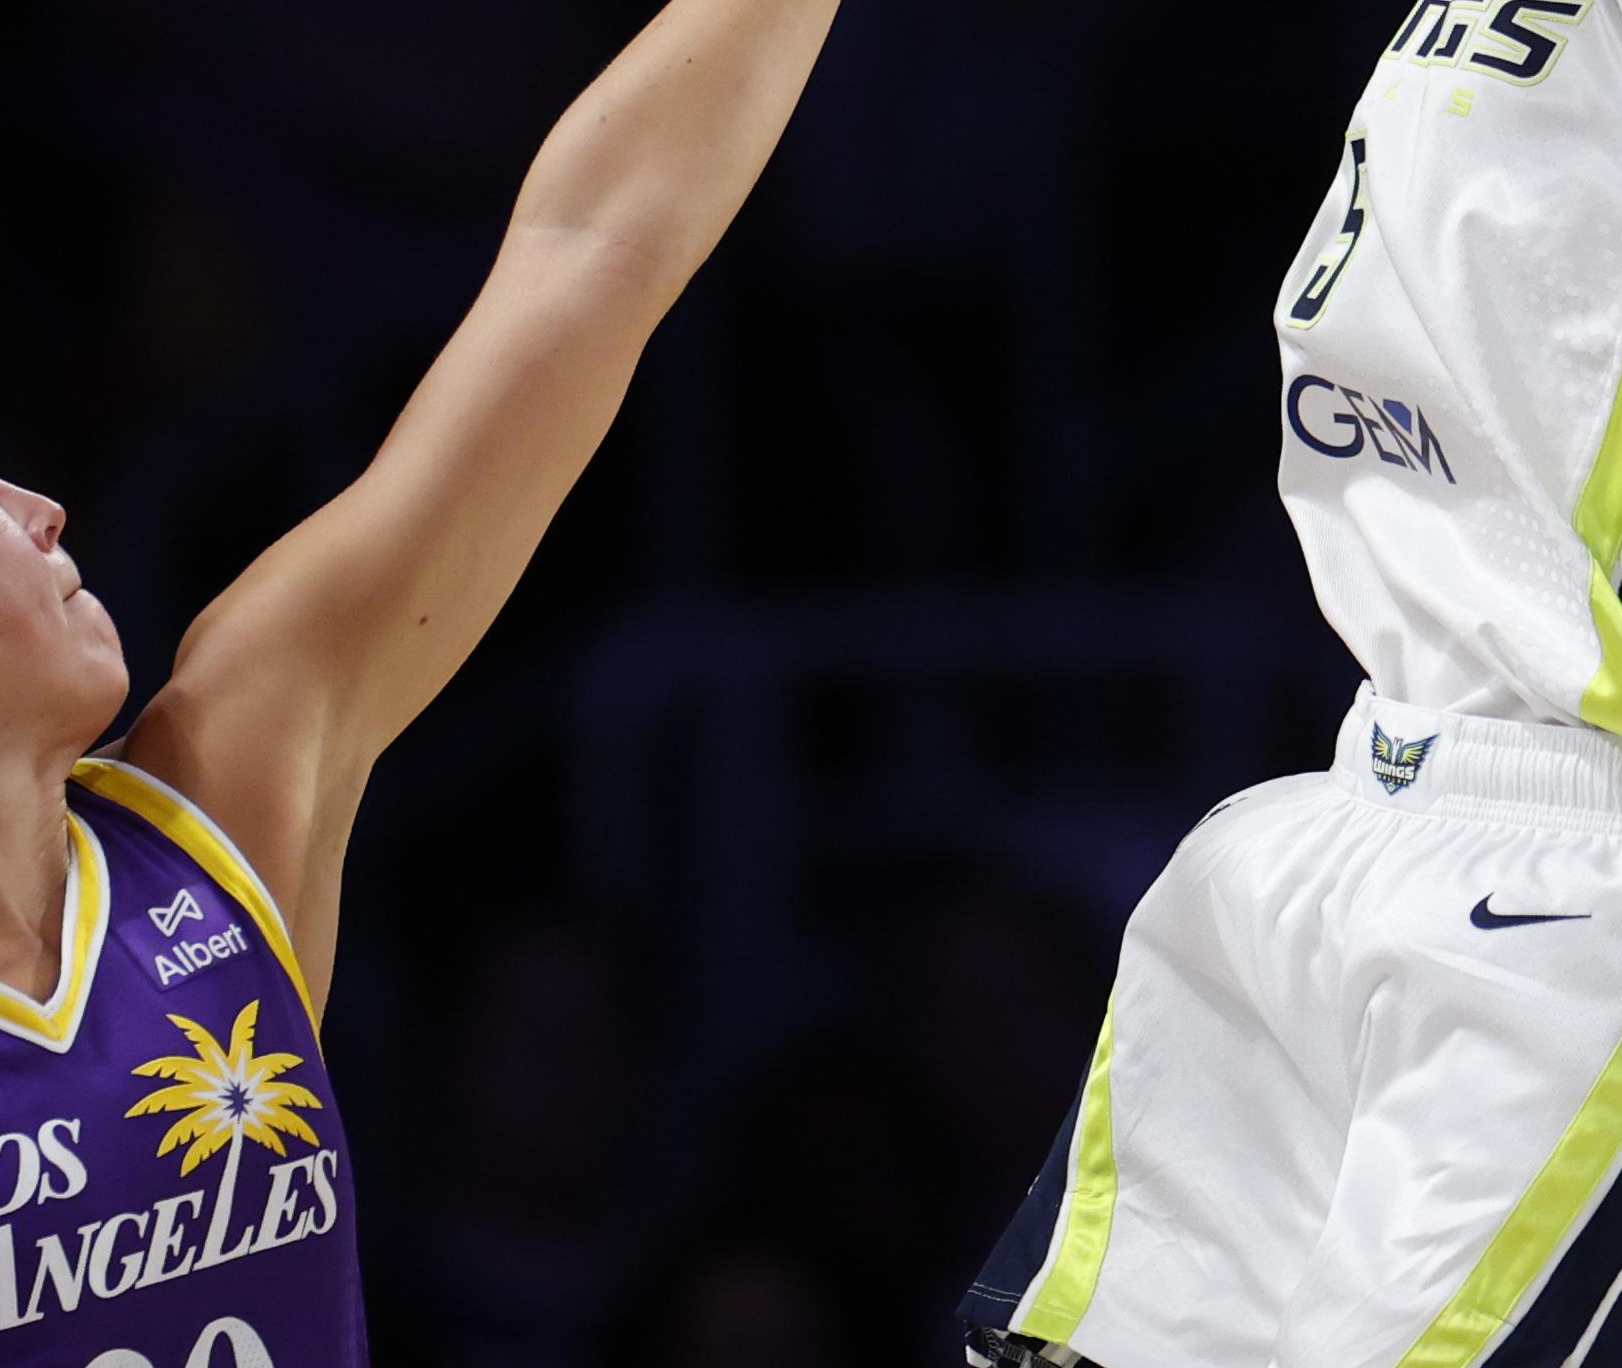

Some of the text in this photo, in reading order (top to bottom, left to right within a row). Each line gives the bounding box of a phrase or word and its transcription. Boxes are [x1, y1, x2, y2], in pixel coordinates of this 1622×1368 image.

[1286, 374, 1457, 484] GEM
[1373, 757, 1416, 781] WINGS
[154, 922, 248, 986] Albert
